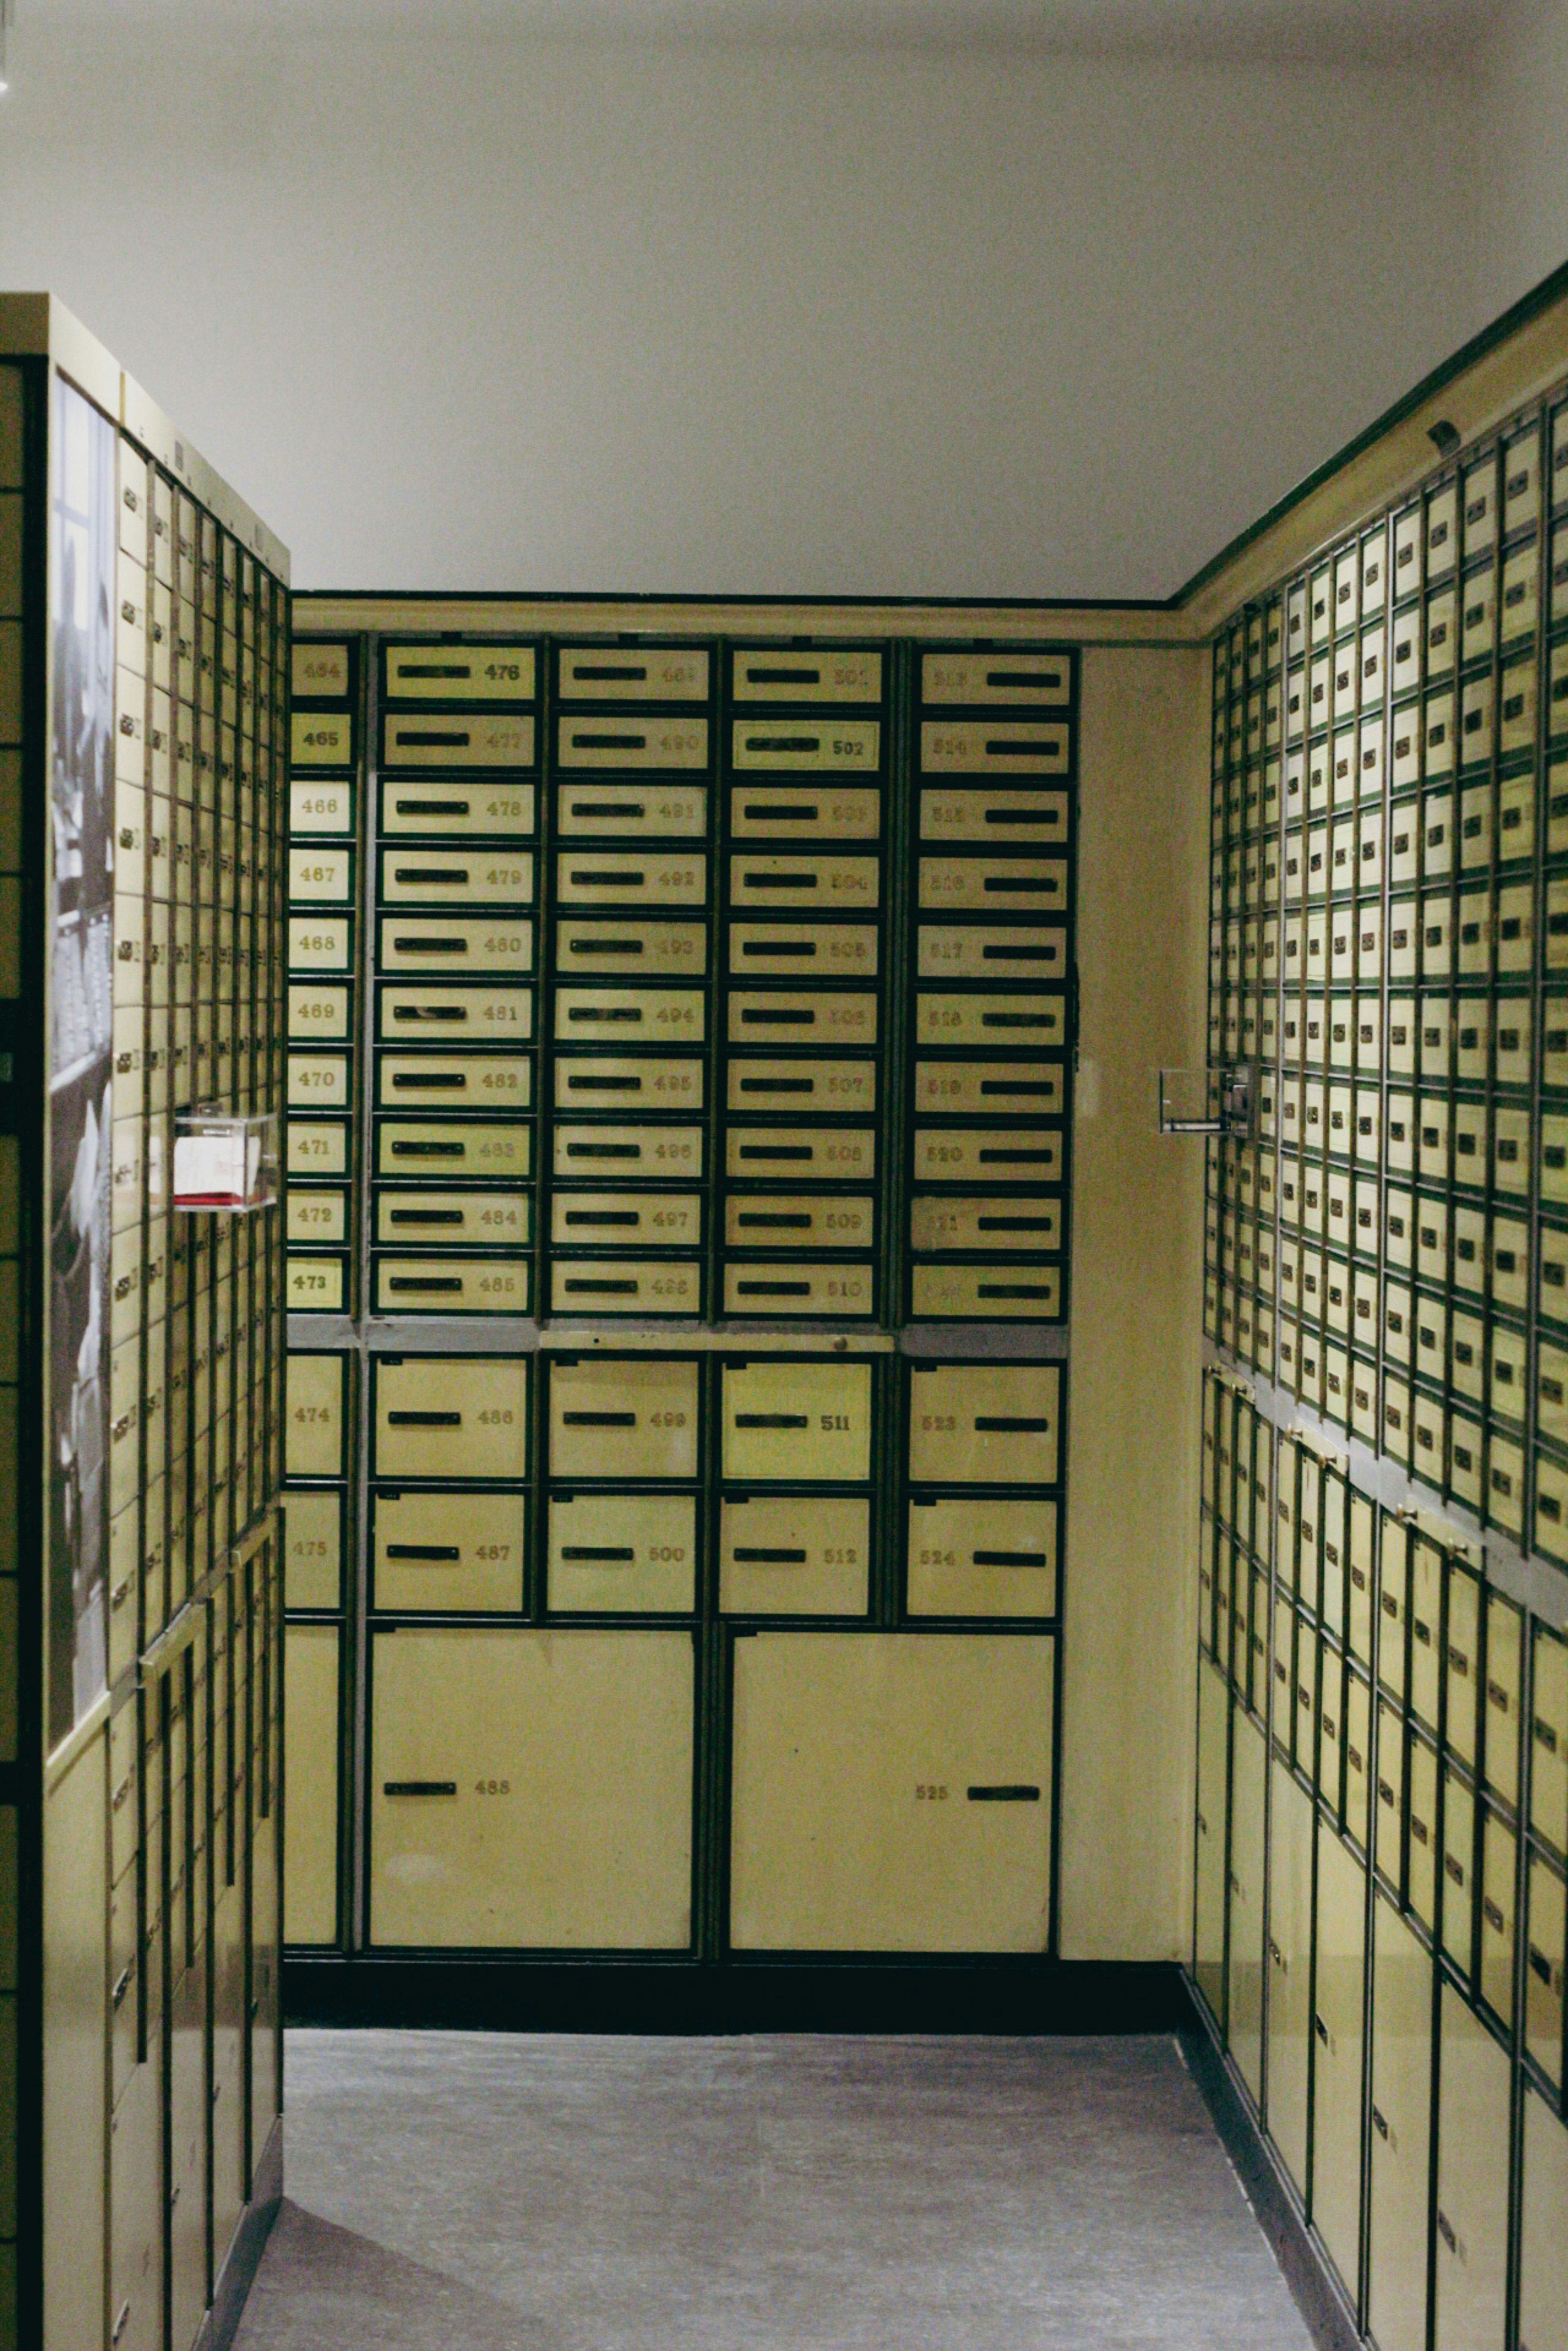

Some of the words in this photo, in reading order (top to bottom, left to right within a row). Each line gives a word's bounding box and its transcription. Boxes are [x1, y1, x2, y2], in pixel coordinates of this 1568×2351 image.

[485, 665, 520, 680] 476
[303, 731, 339, 746] 465
[833, 740, 864, 755] 502
[302, 798, 338, 813] 466
[486, 801, 521, 816] 478
[300, 867, 335, 882] 467
[486, 869, 521, 884] 479
[299, 936, 335, 950] 468
[484, 938, 521, 952] 480
[298, 1004, 335, 1018] 469
[484, 1005, 518, 1020] 481
[657, 1007, 694, 1022] 494
[298, 1072, 335, 1087] 470
[482, 1073, 518, 1088] 482
[297, 1140, 329, 1155] 471
[297, 1208, 332, 1223] 472
[481, 1210, 517, 1224] 484
[653, 1211, 688, 1226] 497
[293, 1275, 327, 1290] 473
[480, 1277, 515, 1292] 485
[295, 1407, 330, 1422] 474
[477, 1409, 513, 1424] 486
[821, 1414, 849, 1430] 511
[293, 1541, 327, 1556] 475
[476, 1545, 510, 1559] 487
[649, 1547, 684, 1561] 500
[824, 1548, 856, 1563] 512
[920, 1549, 956, 1564] 524
[474, 1779, 510, 1795] 488
